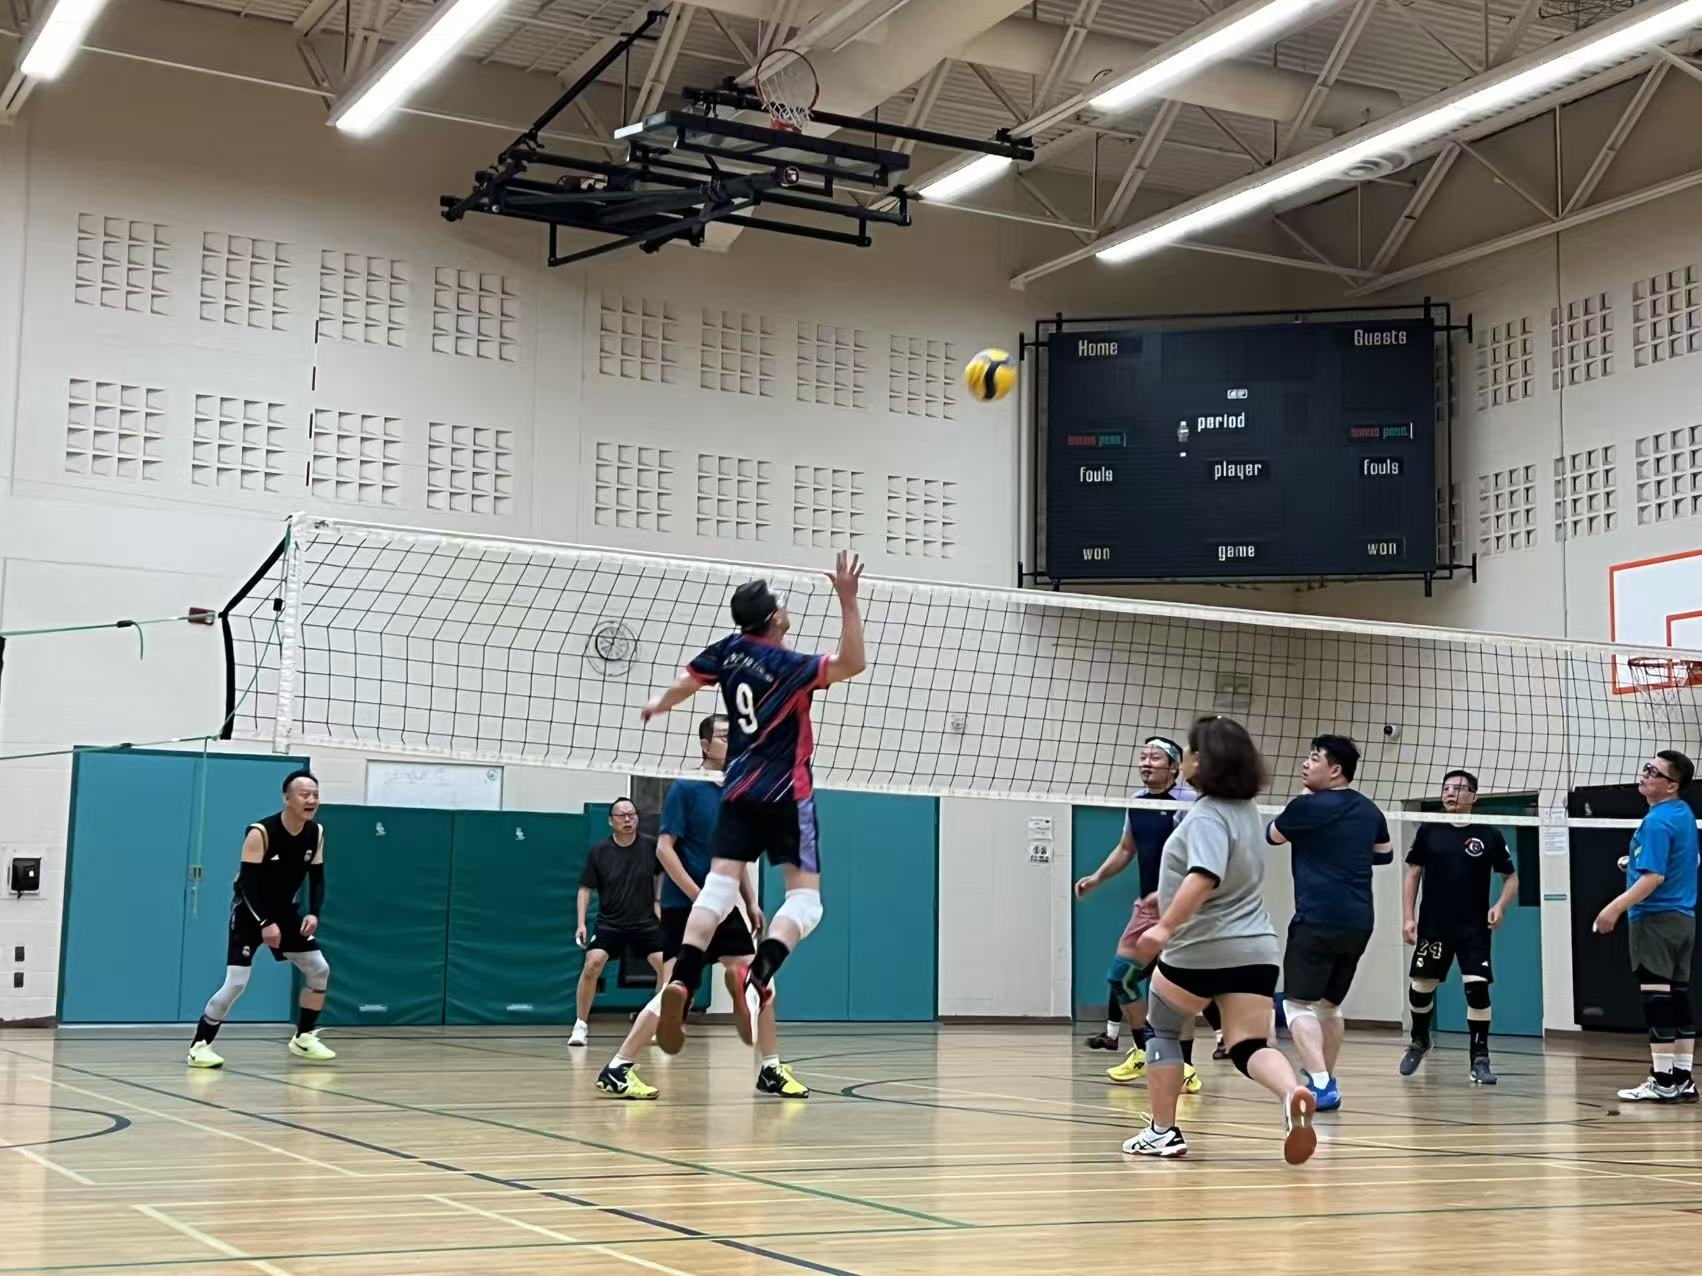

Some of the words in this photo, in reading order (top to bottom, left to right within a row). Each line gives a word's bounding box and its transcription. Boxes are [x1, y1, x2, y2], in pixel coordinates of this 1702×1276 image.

[1354, 329, 1407, 346] Guests
[1078, 339, 1118, 357] Home
[1197, 411, 1245, 433] period
[1079, 466, 1113, 482] fouls
[1214, 460, 1262, 481] player
[1364, 458, 1399, 476] fouls
[1082, 547, 1111, 561] won
[1218, 545, 1255, 562] game
[1367, 542, 1397, 555] won
[735, 682, 758, 734] 9
[1416, 939, 1442, 959] 24
